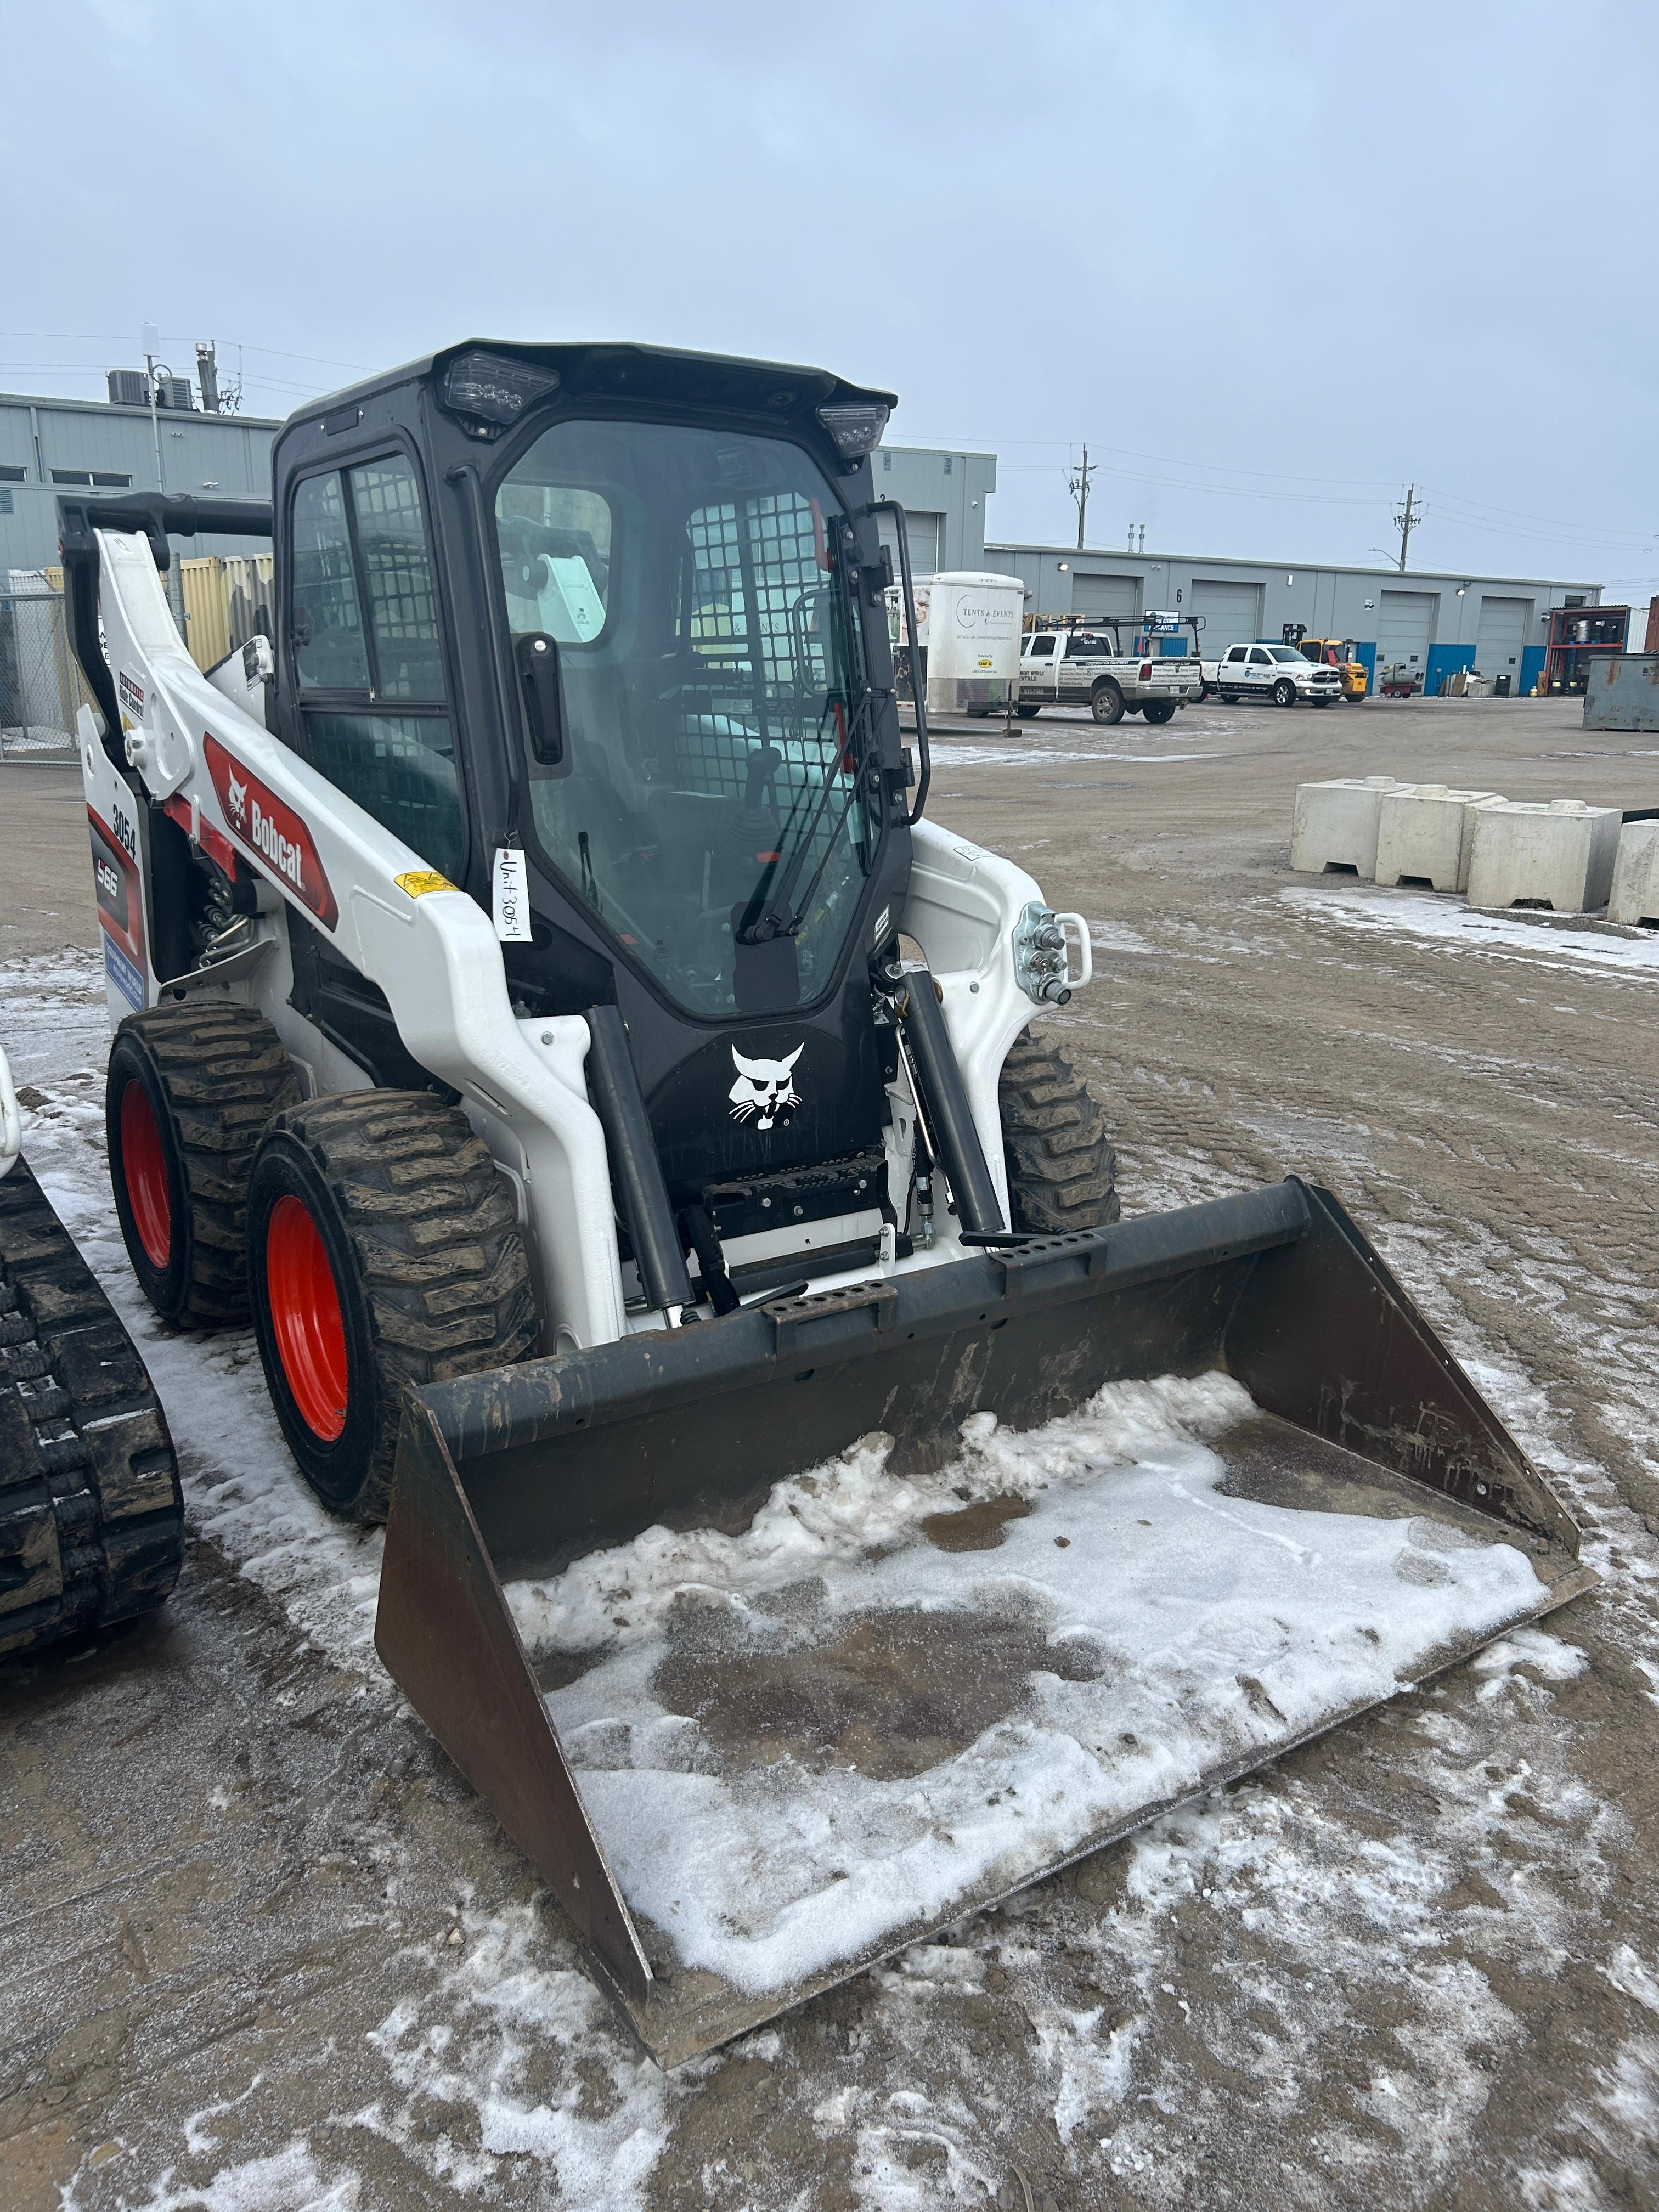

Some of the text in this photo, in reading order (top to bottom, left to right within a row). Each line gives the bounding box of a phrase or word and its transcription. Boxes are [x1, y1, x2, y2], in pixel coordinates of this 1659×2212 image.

[963, 608, 984, 617] TENTS
[992, 610, 1014, 618] EVENTS
[1177, 589, 1182, 603] 6
[120, 673, 144, 702] AUTOMATIC
[120, 684, 144, 719] Ride Control
[113, 803, 136, 861] 3054
[252, 799, 302, 889] Bobcat
[98, 859, 118, 897] S66
[500, 861, 521, 937] Unit 3054
[127, 968, 142, 995] WORLD
